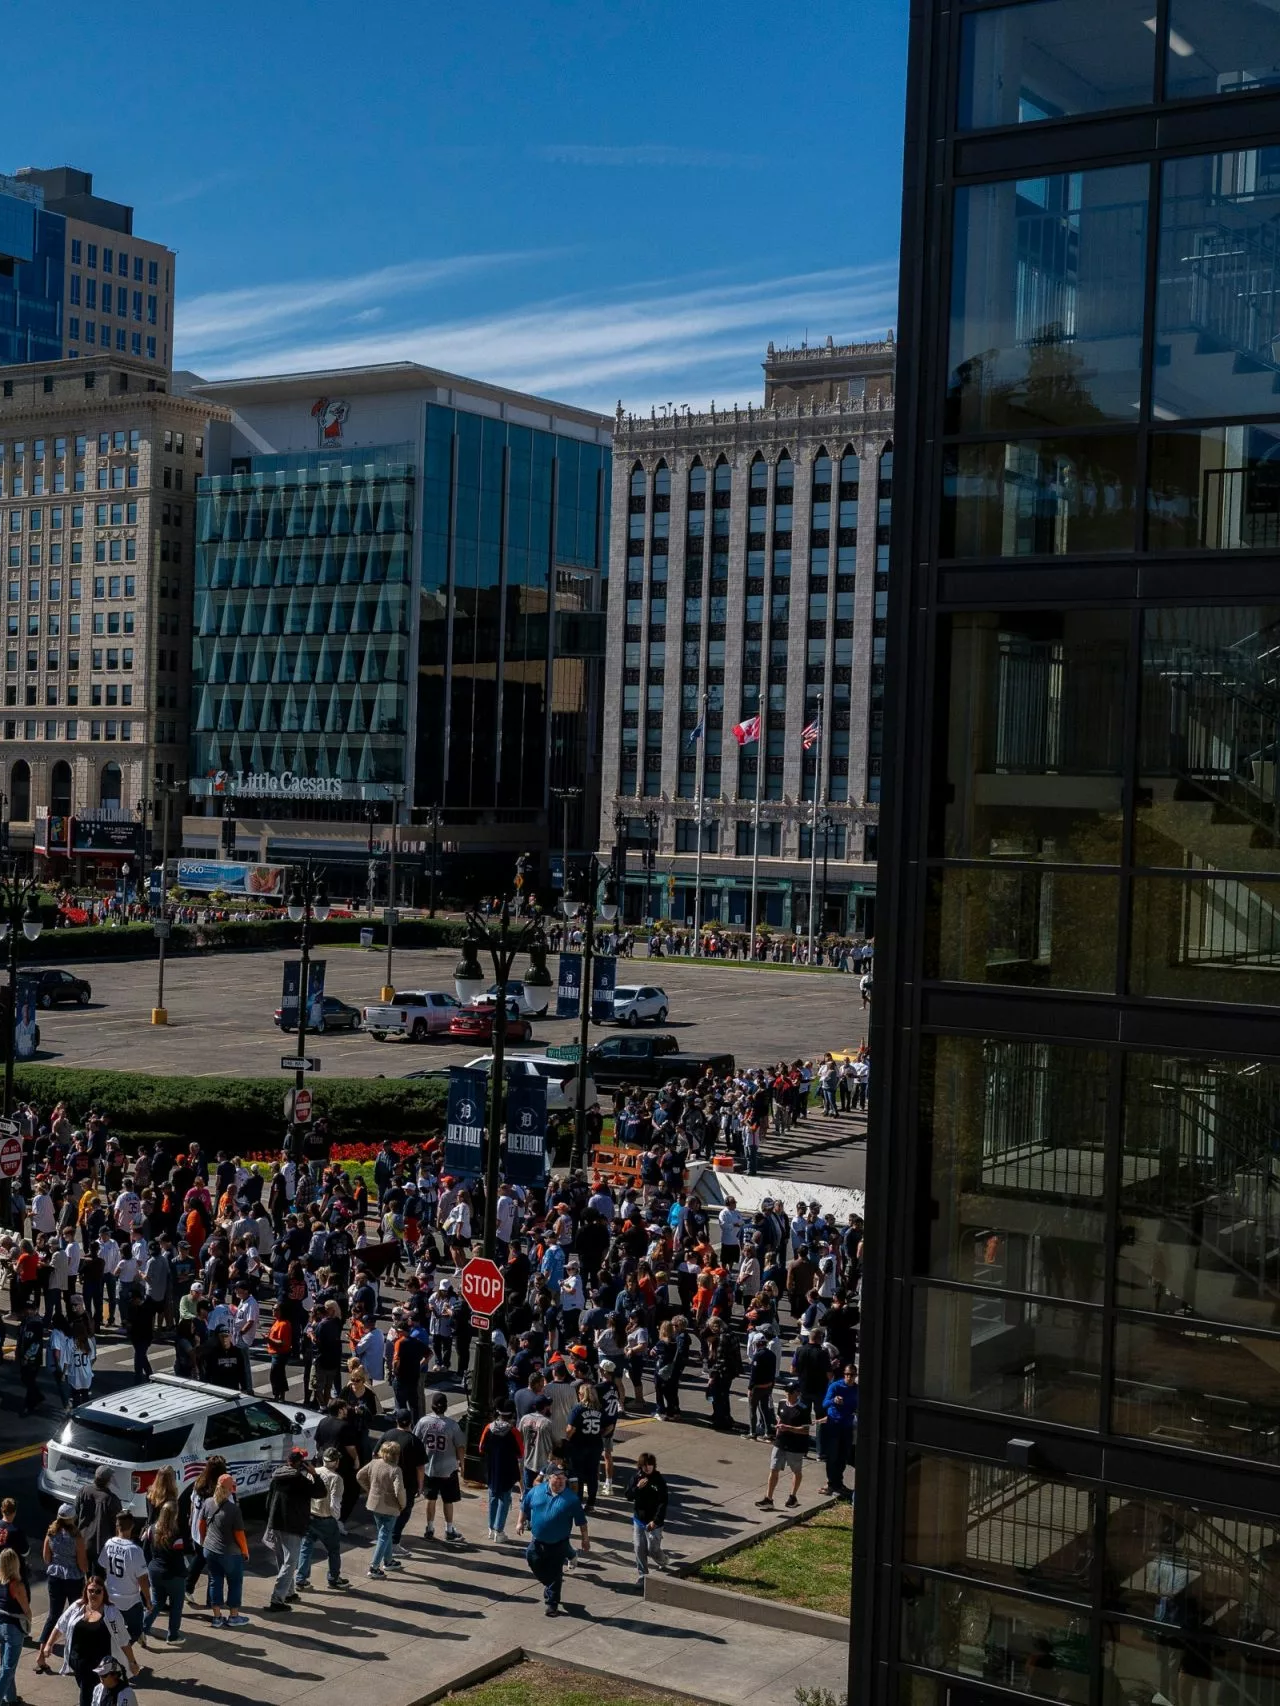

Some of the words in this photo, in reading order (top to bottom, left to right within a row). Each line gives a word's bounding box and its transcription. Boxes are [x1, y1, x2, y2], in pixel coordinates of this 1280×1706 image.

[236, 771, 278, 791] Little
[281, 771, 342, 792] Caesars
[181, 863, 204, 875] Sysco
[0, 1123, 9, 1131] WAY
[448, 1124, 482, 1143] DETROIT
[11, 1144, 20, 1152] NOT
[508, 1132, 543, 1152] DETROIT
[4, 1161, 18, 1169] ENTER
[128, 1202, 138, 1214] 35
[464, 1273, 501, 1299] STOP
[582, 1419, 600, 1435] 35
[427, 1434, 445, 1450] 28
[94, 1457, 122, 1466] POLICE
[109, 1556, 124, 1578] 15
